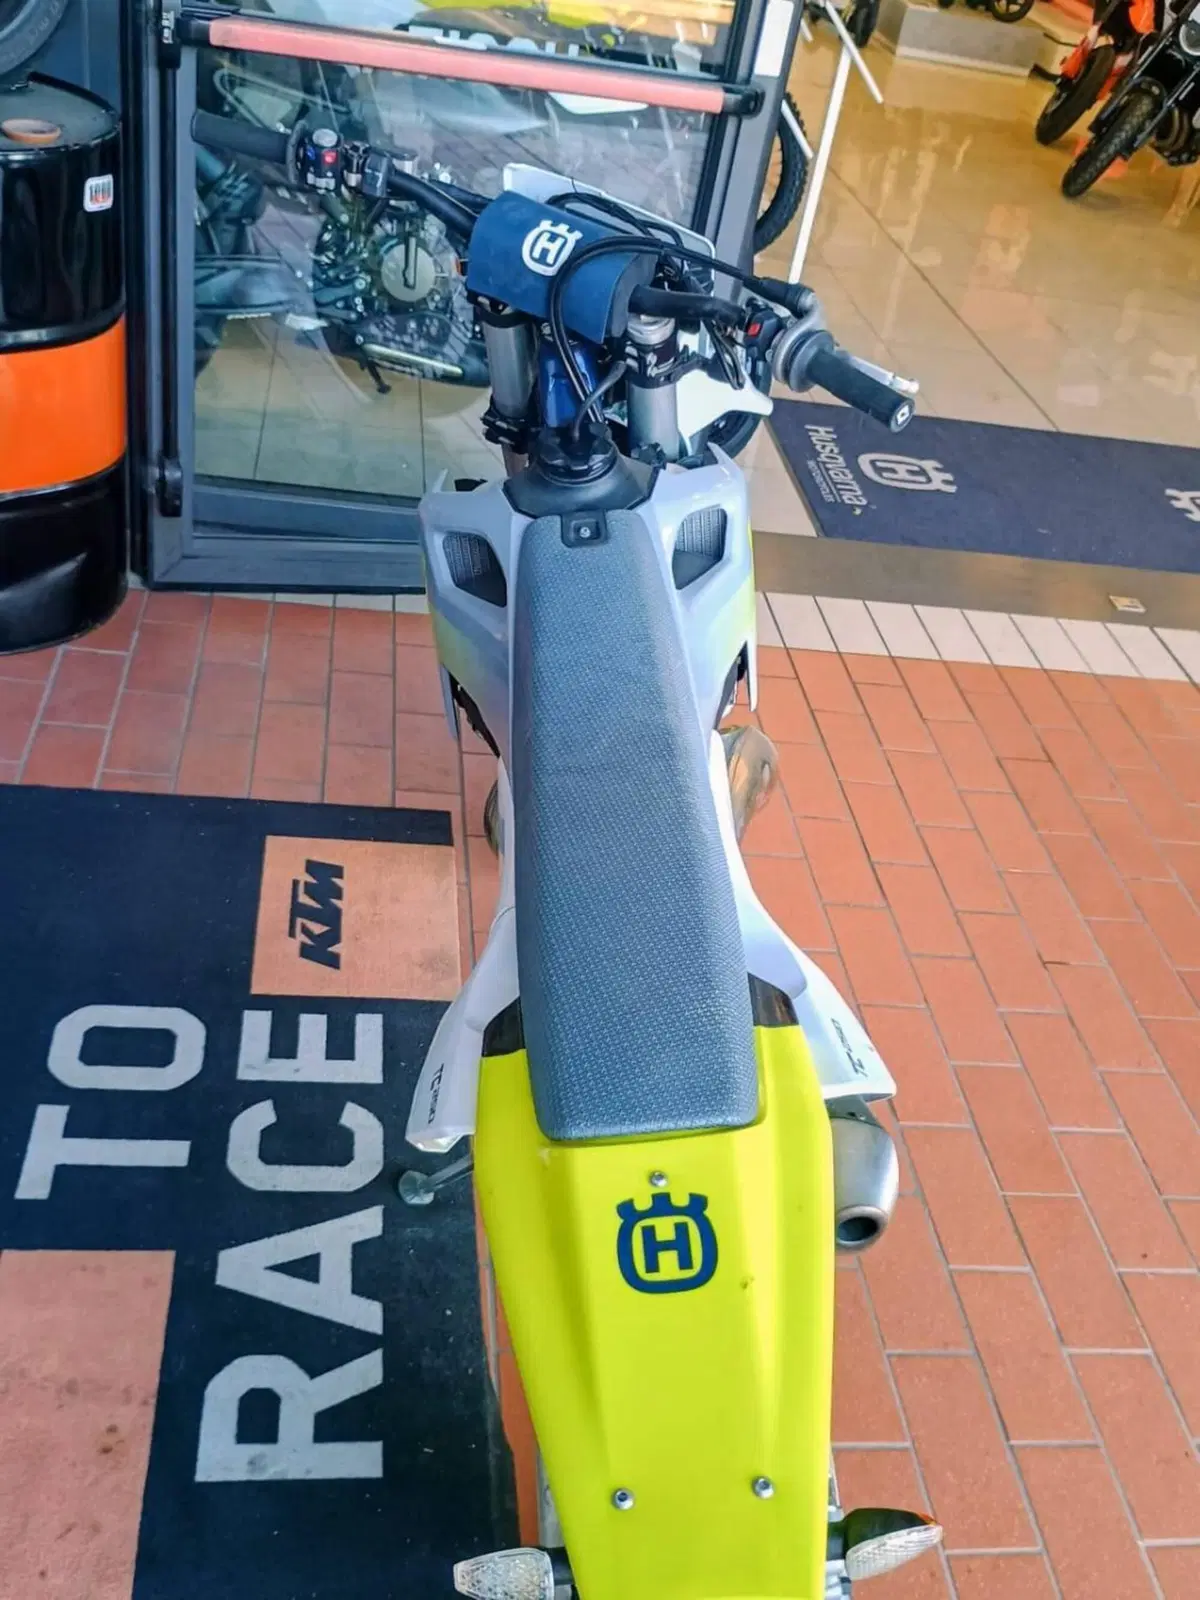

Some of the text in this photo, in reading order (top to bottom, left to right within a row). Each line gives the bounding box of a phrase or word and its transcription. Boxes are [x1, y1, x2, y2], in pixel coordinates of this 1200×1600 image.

[804, 424, 868, 506] Husqvarna
[289, 859, 344, 970] KTM
[14, 1003, 207, 1201] TO
[194, 1009, 384, 1483] RACE
